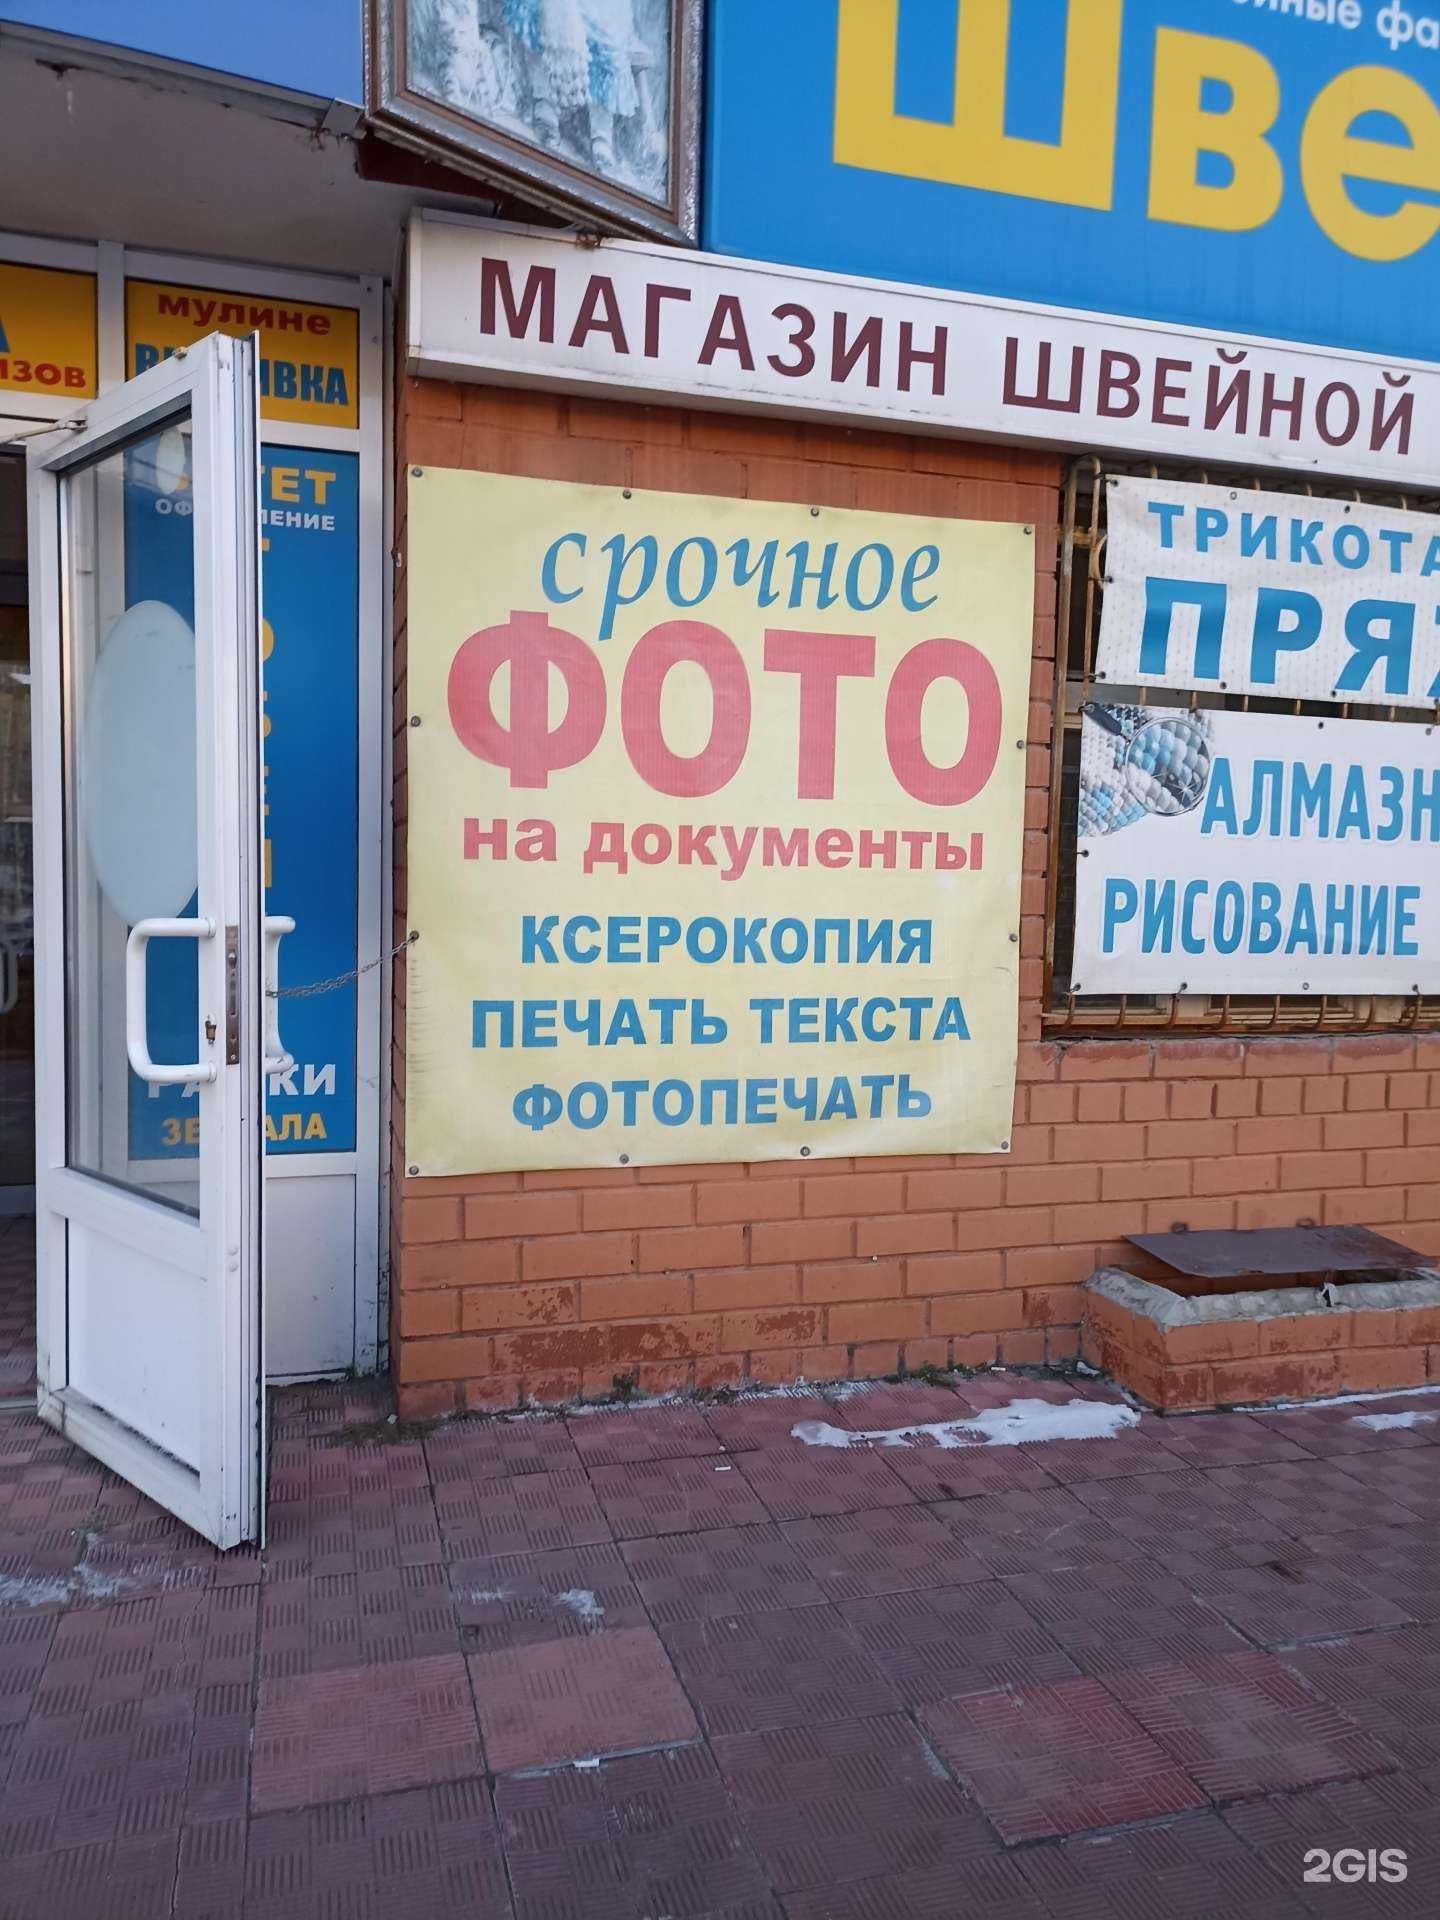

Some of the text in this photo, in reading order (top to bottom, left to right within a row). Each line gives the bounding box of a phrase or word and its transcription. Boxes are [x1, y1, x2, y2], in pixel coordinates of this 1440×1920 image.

[832, 0, 1440, 262] Шве
[157, 293, 332, 336] мулине
[480, 256, 1415, 456] МАГАЗИН ШВЕЙНОЙ
[541, 530, 941, 641] срочное
[447, 609, 1003, 807] ФОТО
[464, 817, 984, 882] на документы
[521, 915, 933, 964] КСЕРОКОПИЯ
[1103, 877, 1420, 957] РИСОВАНИЕ
[471, 996, 971, 1049] ПЕЧАТЬ ТЕКСТА
[512, 1073, 933, 1131] ФОТОПЕЧАТЬ
